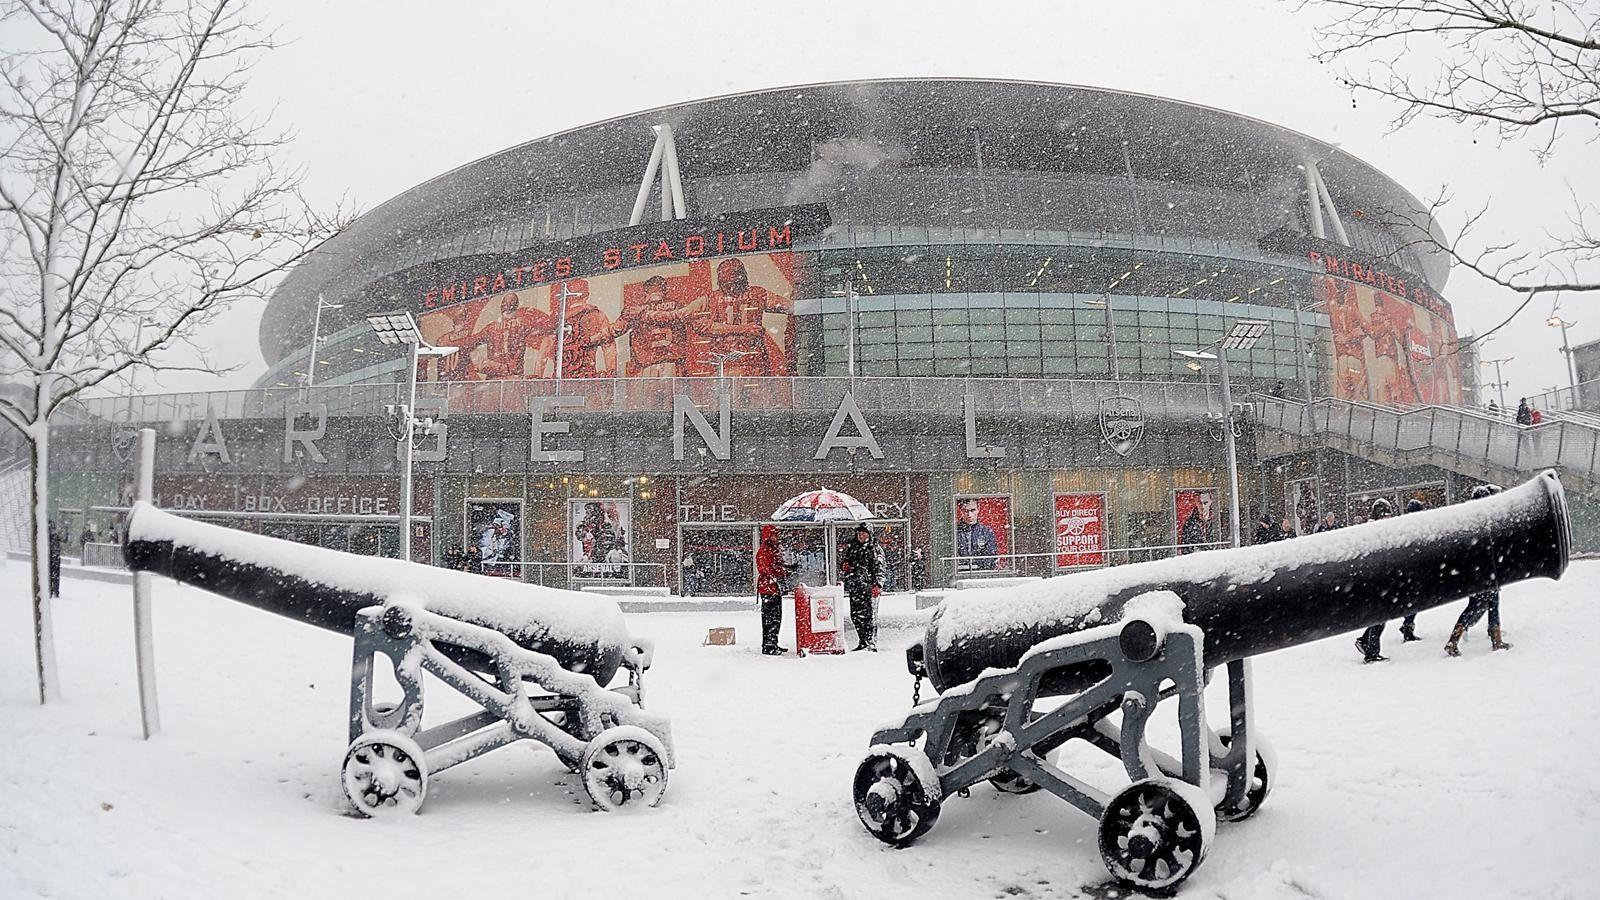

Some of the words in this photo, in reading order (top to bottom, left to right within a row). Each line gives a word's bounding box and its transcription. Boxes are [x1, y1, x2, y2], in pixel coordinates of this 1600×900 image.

[424, 256, 573, 308] EMIRATES
[603, 224, 792, 270] STADIUM
[187, 390, 1006, 464] ARSENAL
[174, 493, 207, 510] DAY
[244, 495, 287, 512] BOX
[308, 496, 389, 515] OFFICE
[680, 504, 738, 521] THE
[1072, 508, 1097, 516] DIRECT
[1057, 534, 1099, 546] SUPPORT
[1056, 545, 1078, 553] YOUR
